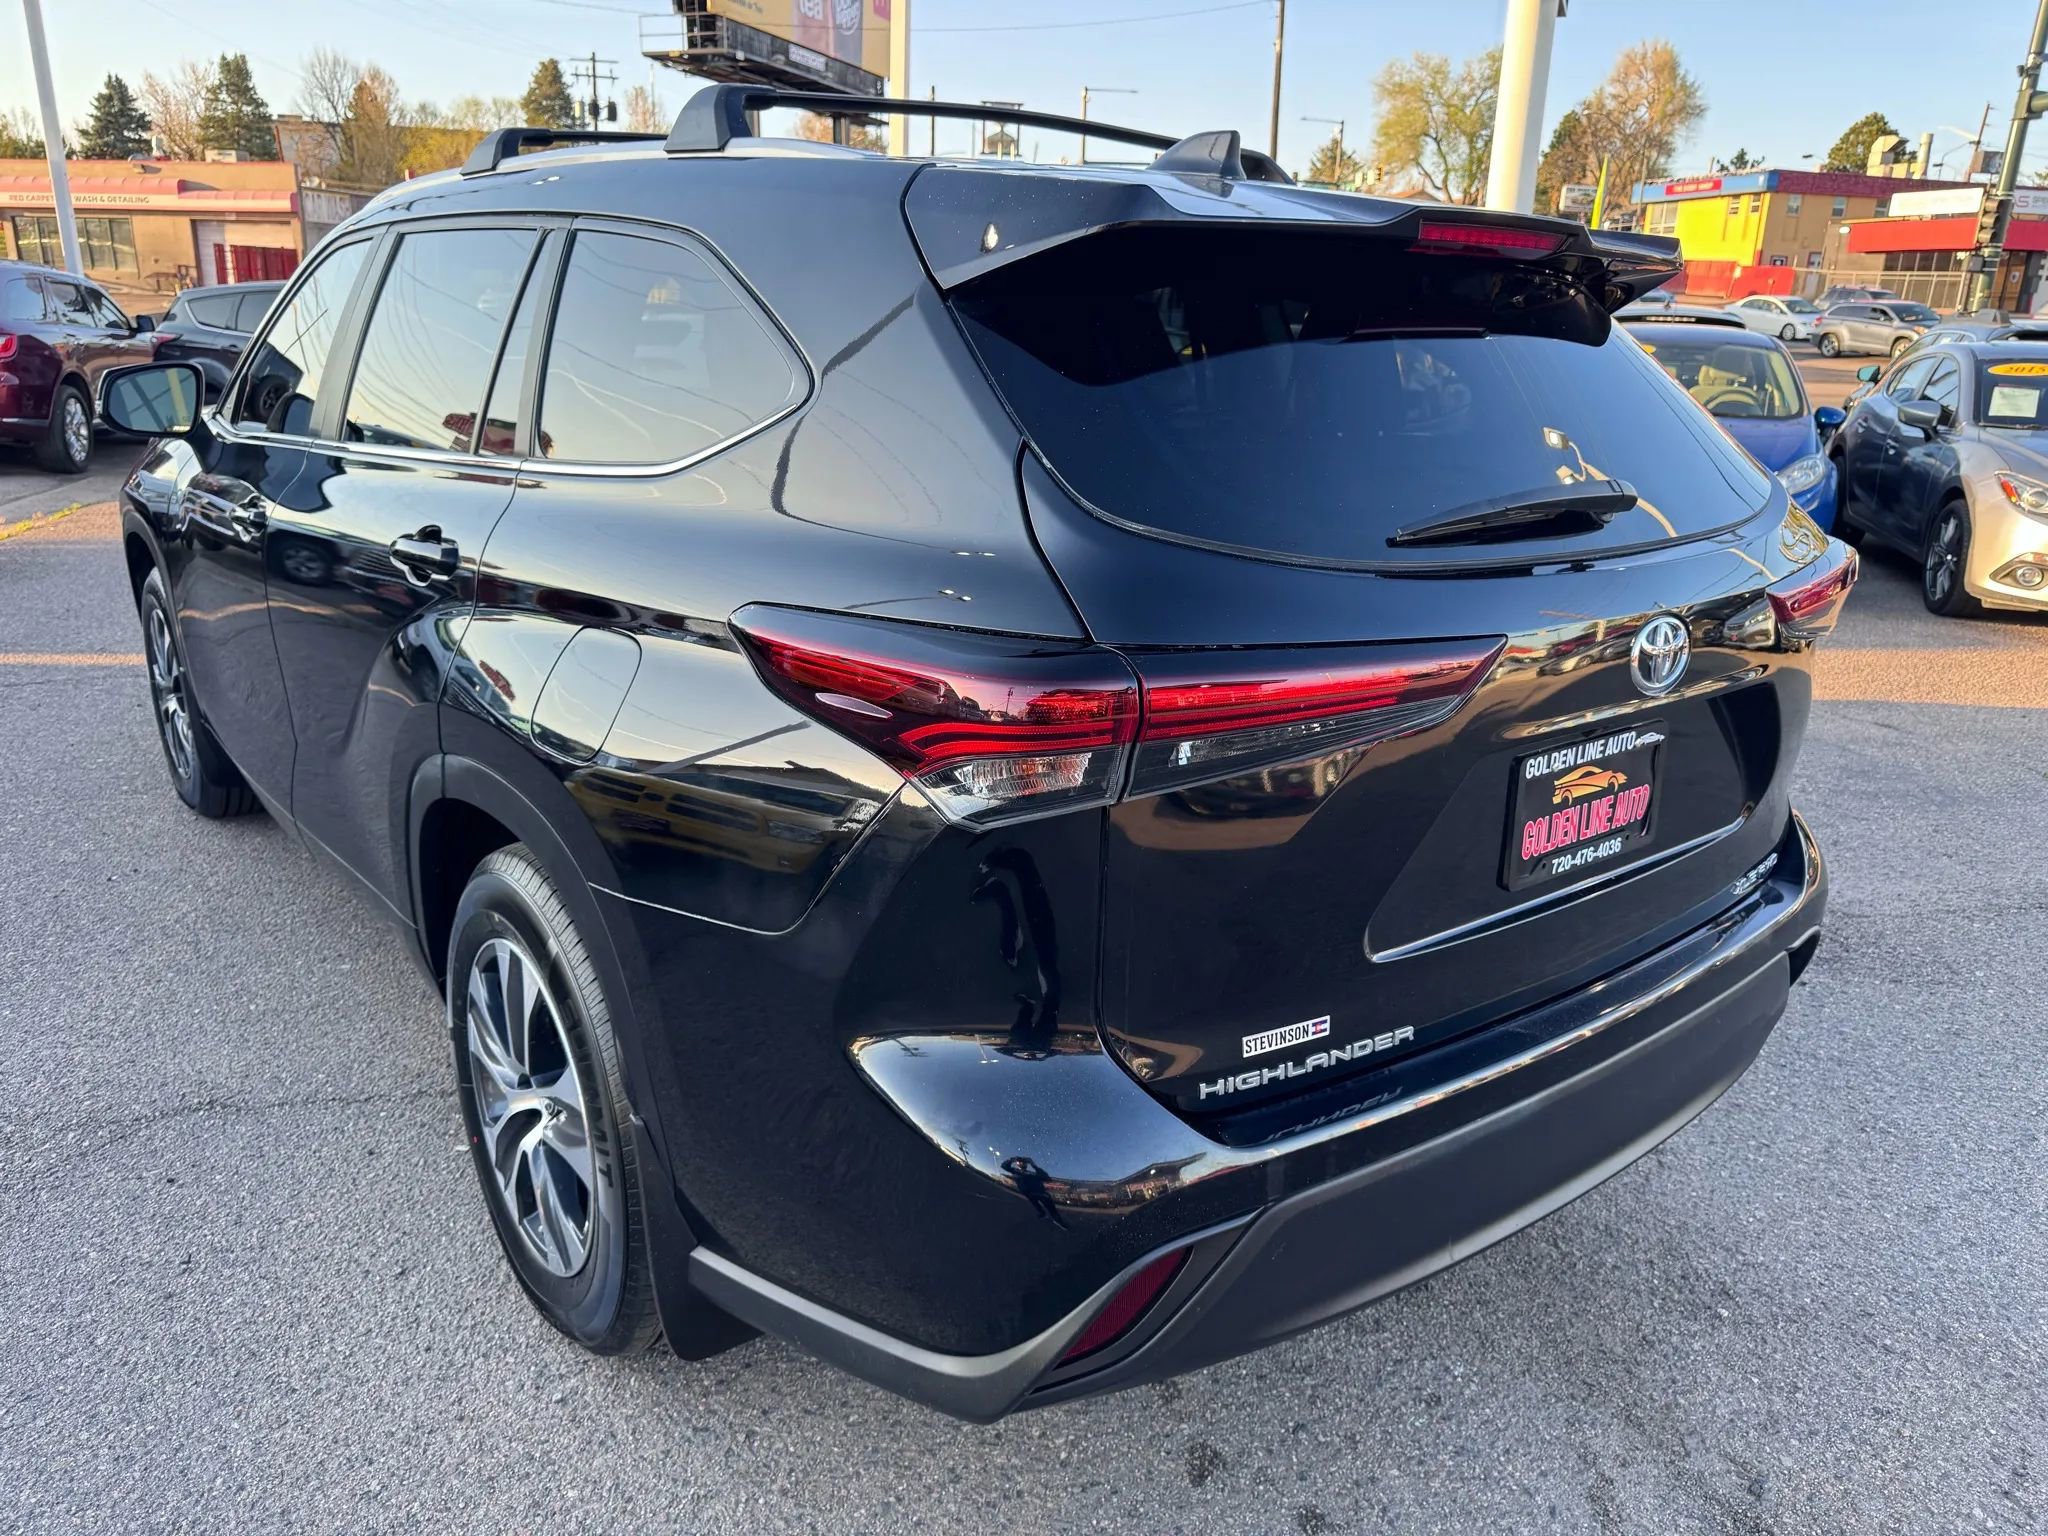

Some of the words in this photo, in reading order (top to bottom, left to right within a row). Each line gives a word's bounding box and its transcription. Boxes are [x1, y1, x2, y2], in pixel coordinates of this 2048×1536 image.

[107, 196, 150, 204] DETAILING
[1526, 746, 1576, 779] GOLDEN
[1576, 739, 1606, 764] LINE
[1605, 731, 1637, 753] AUTO
[1522, 805, 1580, 861] GOLDEN
[1580, 795, 1614, 840] LINE
[1612, 783, 1650, 830] AUTO
[1551, 837, 1622, 875] 720-476-4036
[1244, 1023, 1310, 1055] STEVINSON
[1199, 1025, 1415, 1100] HIGHLANDER
